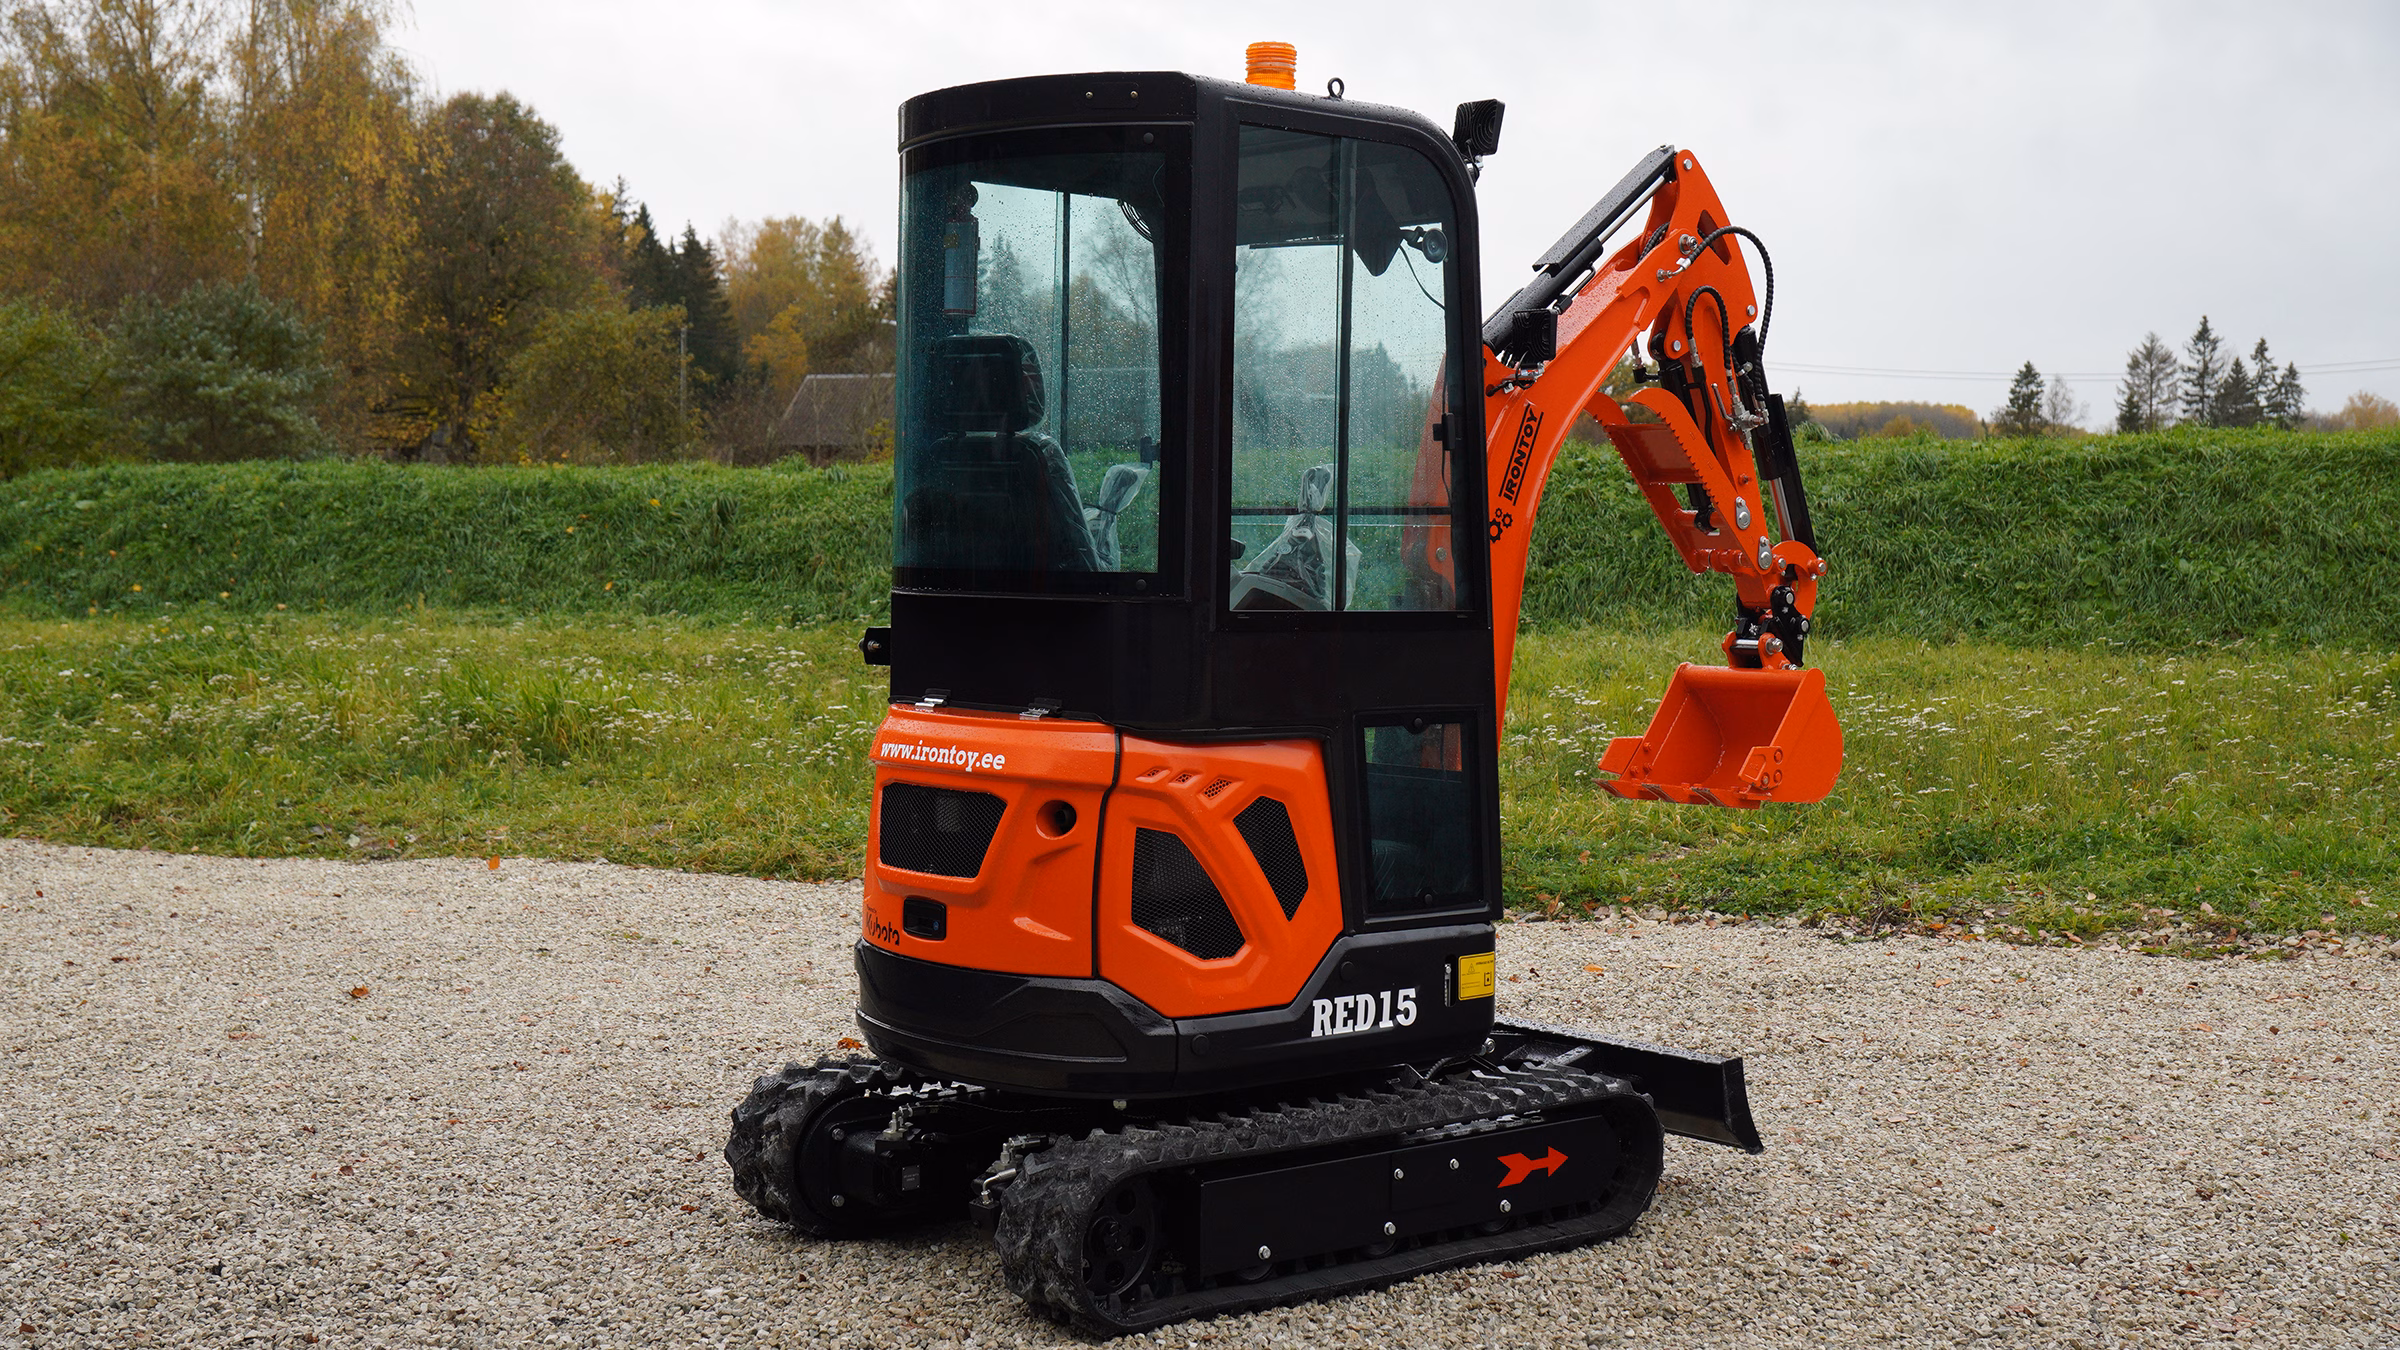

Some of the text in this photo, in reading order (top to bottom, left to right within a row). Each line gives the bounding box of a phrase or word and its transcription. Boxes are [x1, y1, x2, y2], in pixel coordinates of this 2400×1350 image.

[1503, 408, 1537, 501] IRONTOY
[880, 740, 1006, 772] www.irontoy.ee
[866, 911, 900, 946] Kubota
